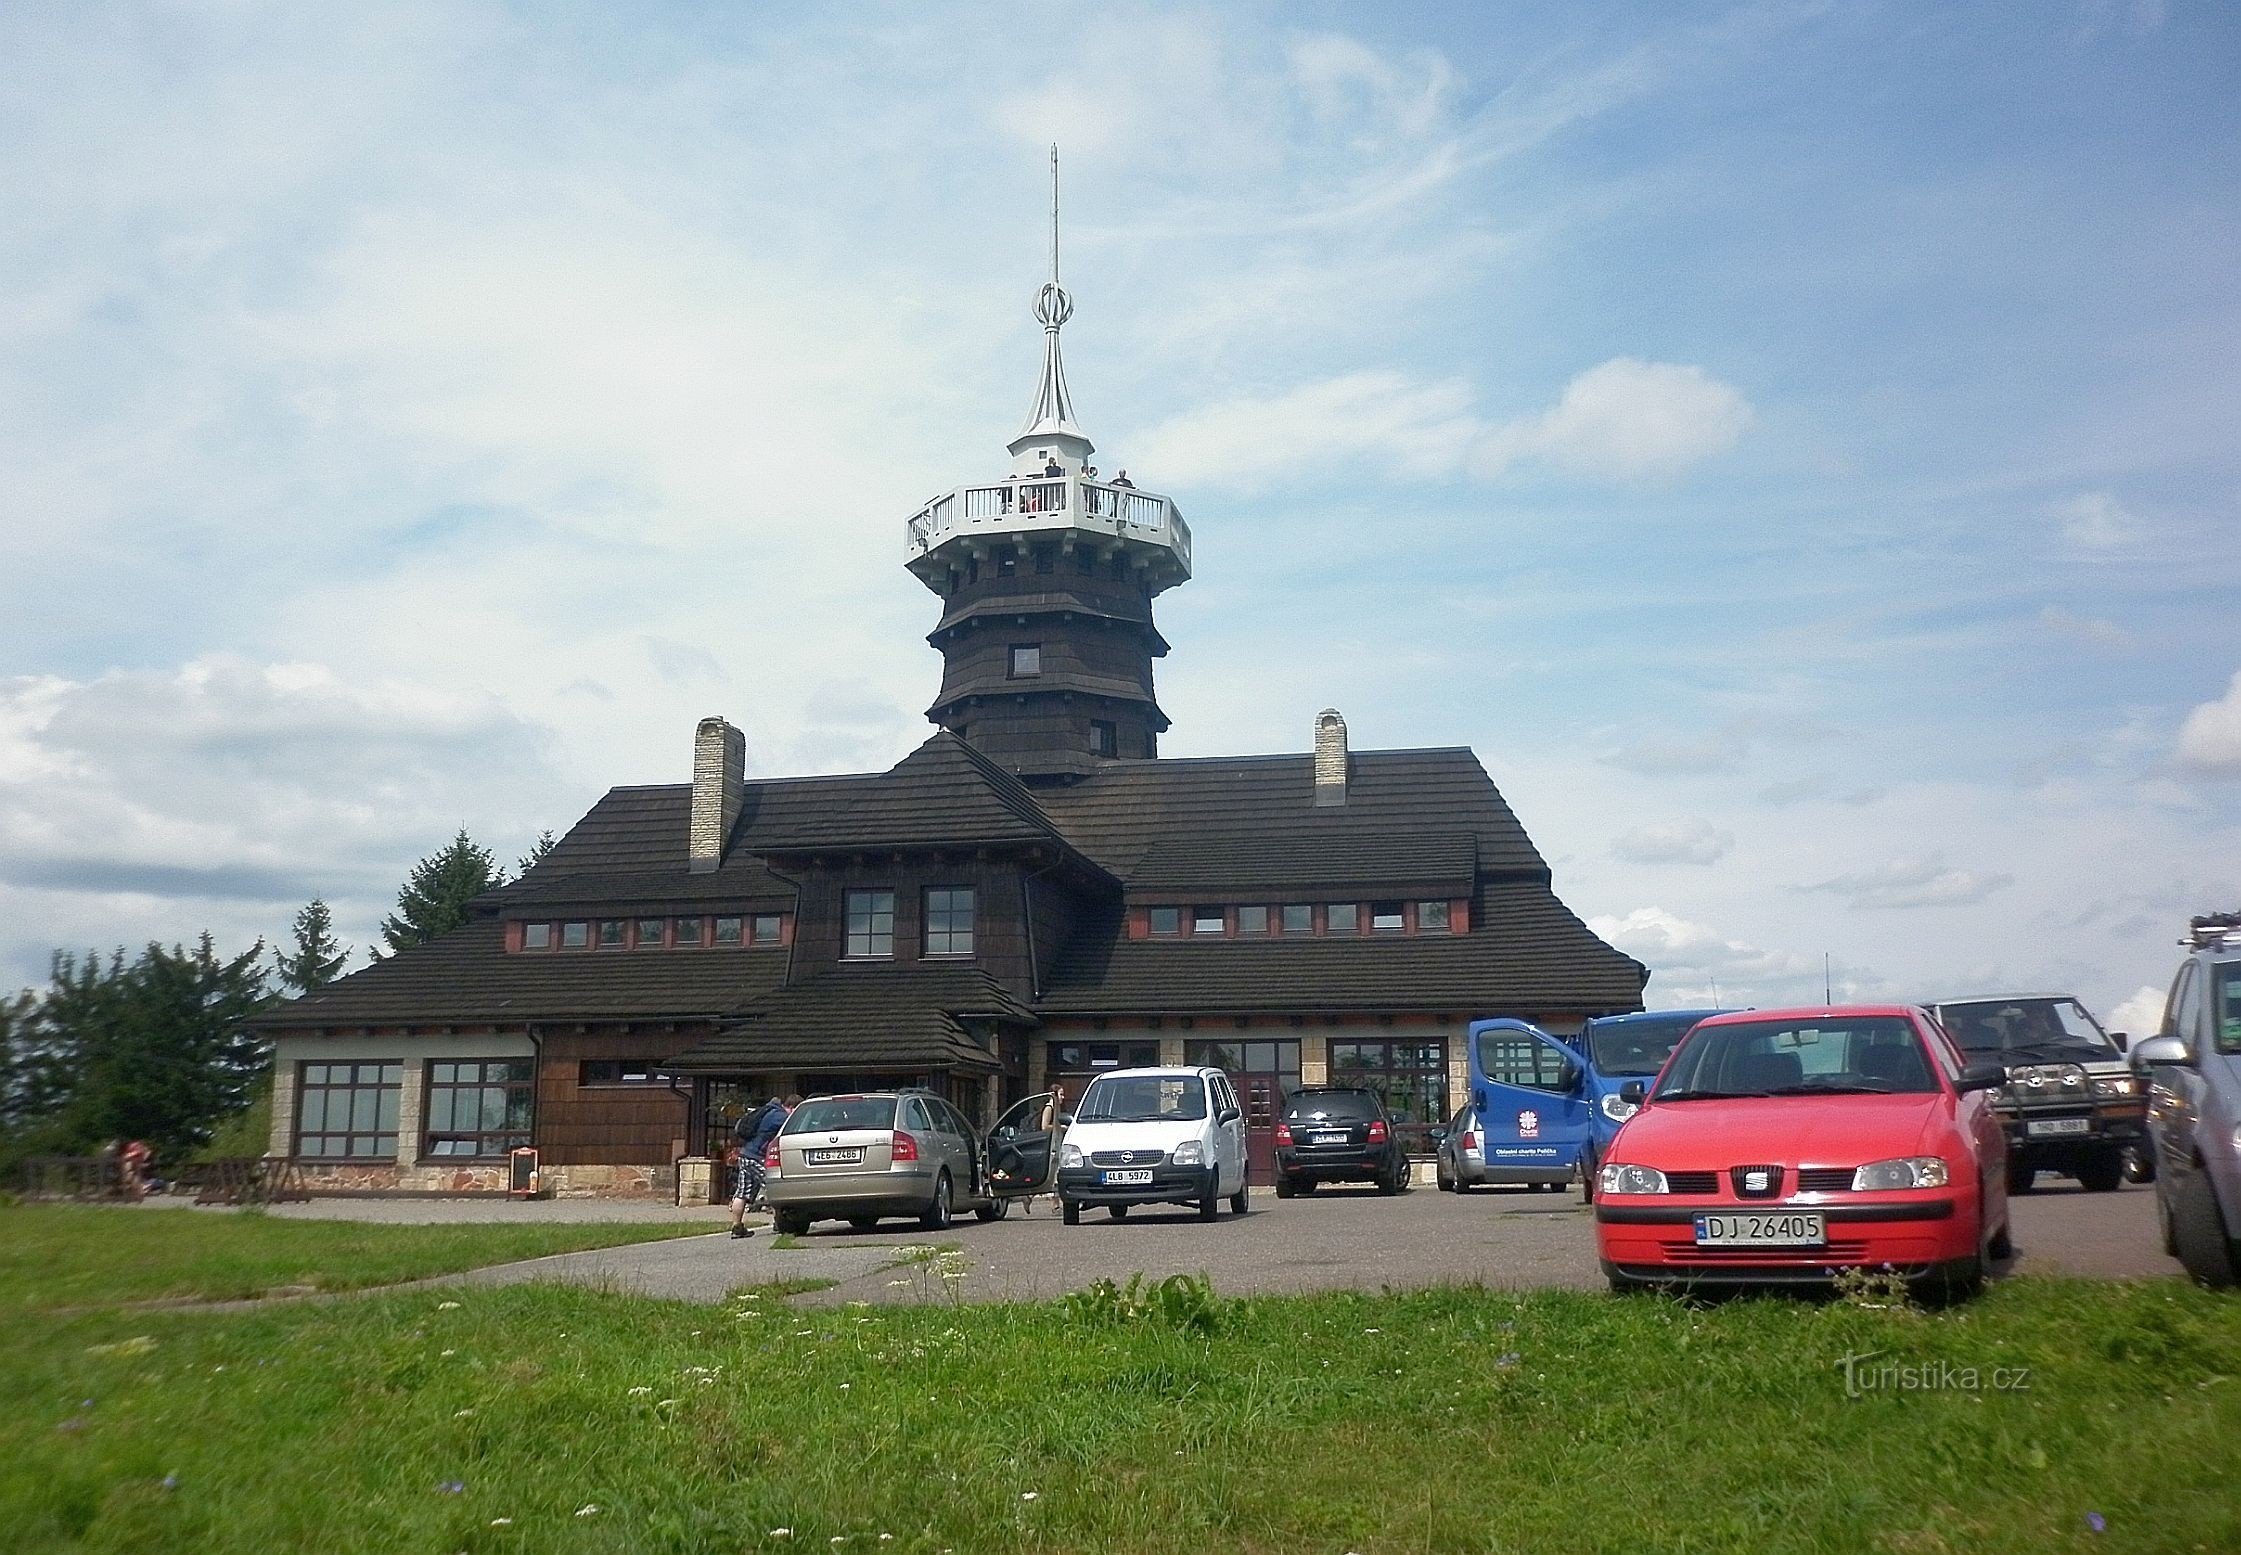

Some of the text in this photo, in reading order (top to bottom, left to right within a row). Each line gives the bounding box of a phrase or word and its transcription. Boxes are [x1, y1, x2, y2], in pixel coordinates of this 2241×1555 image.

[815, 1151, 832, 1160] 4E6
[1107, 1171, 1150, 1181] 4L8 5972
[1708, 1217, 1738, 1239] DJ
[1748, 1216, 1820, 1239] 26405
